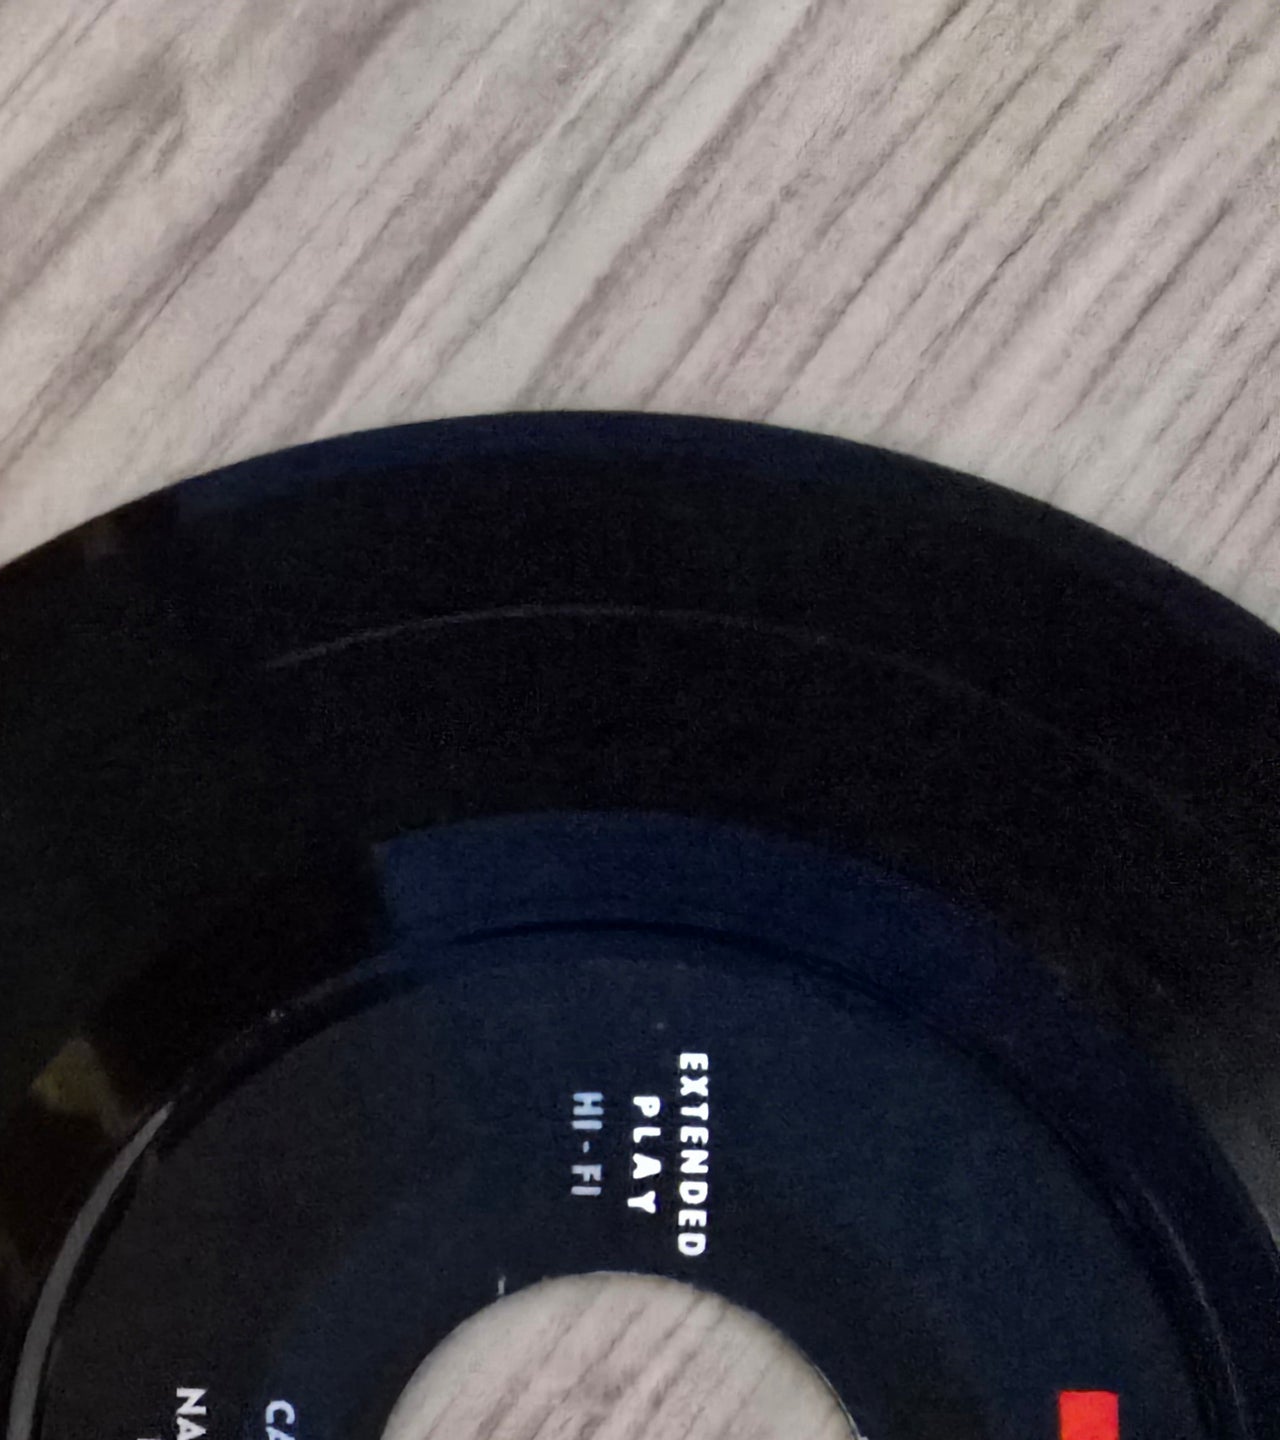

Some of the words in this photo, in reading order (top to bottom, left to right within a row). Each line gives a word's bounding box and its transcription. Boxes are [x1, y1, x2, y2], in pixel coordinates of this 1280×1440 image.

[571, 1092, 604, 1195] HI-FI
[627, 1095, 662, 1214] PLAY
[678, 1052, 709, 1256] EXTENDED
